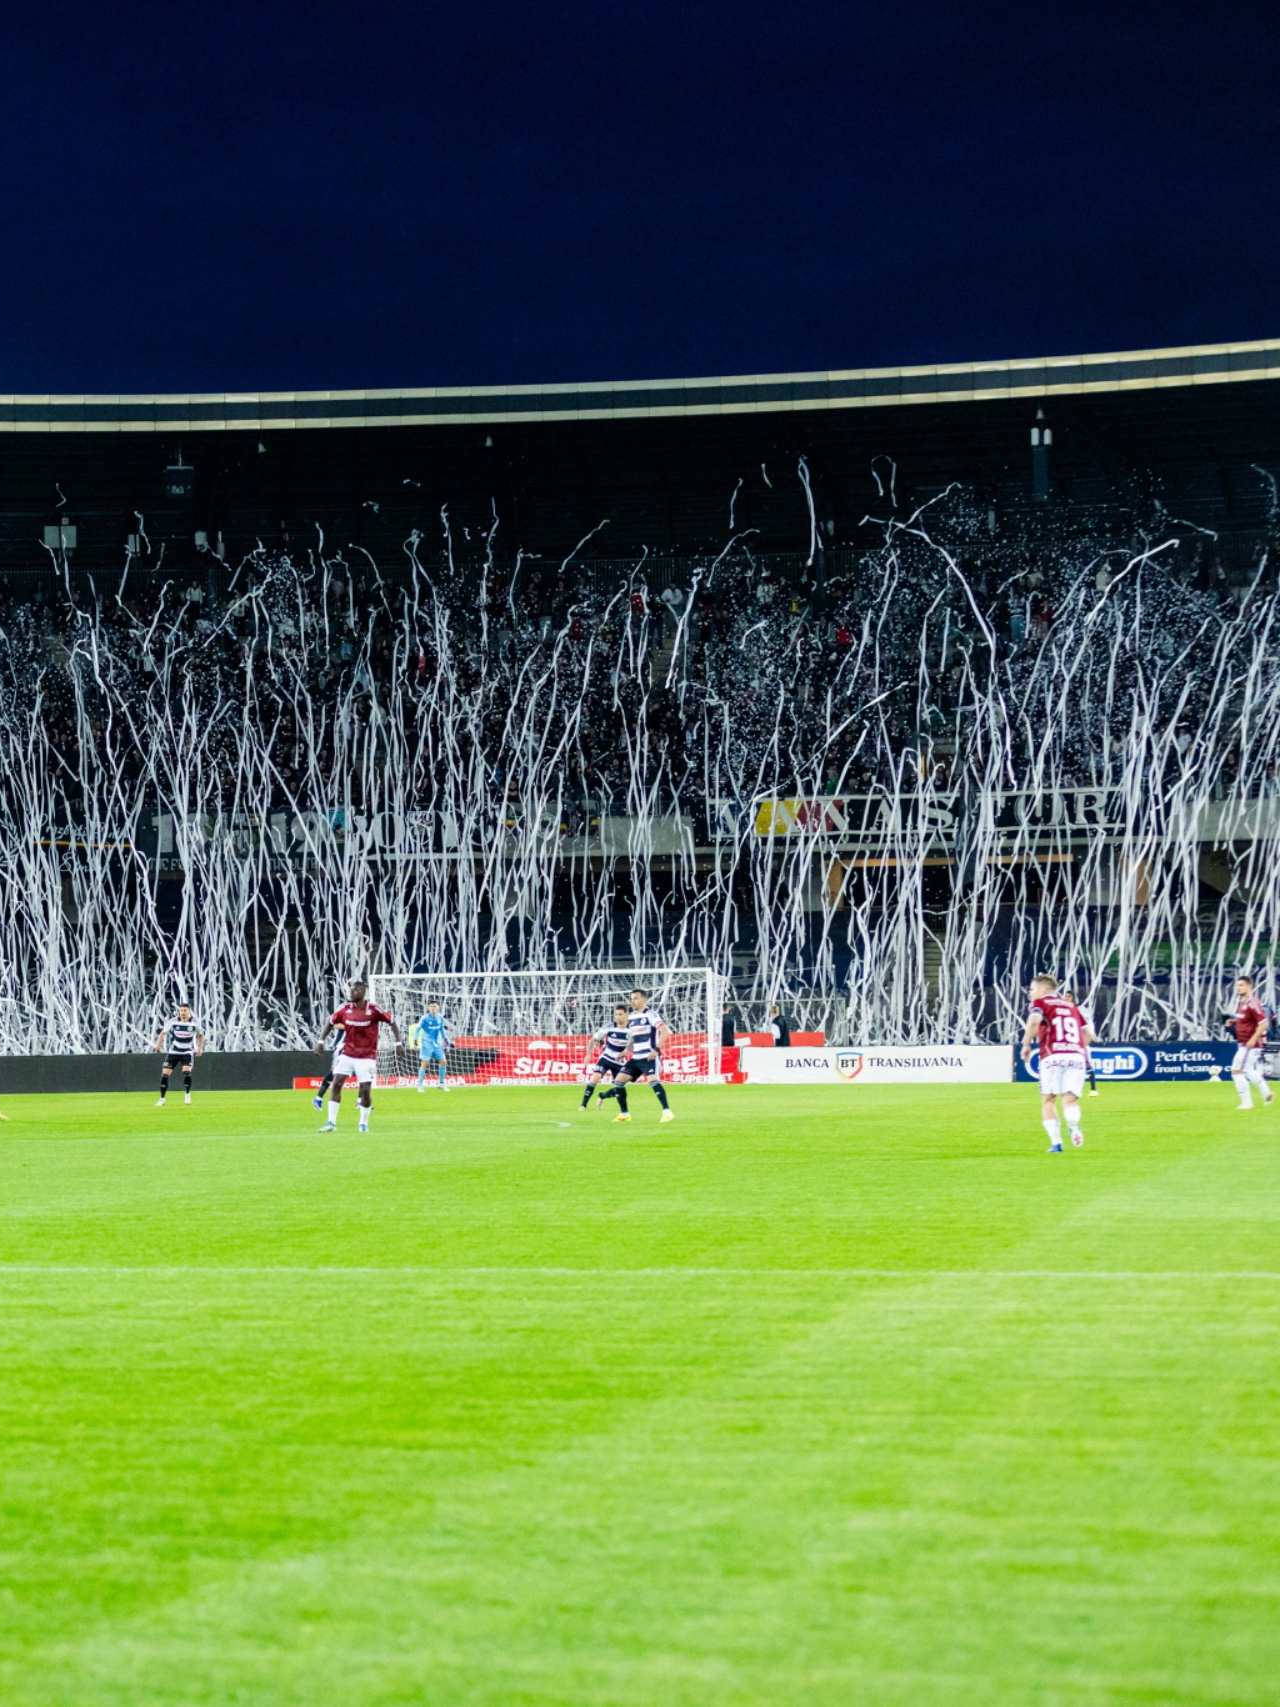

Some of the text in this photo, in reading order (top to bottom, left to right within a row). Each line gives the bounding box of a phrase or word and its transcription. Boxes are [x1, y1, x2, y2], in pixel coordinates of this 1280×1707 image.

[1051, 1015, 1079, 1043] 19
[1156, 1050, 1215, 1063] Perfetto.
[785, 1057, 963, 1068] BANCA BT TRANSILVANIA
[1155, 1064, 1181, 1073] from
[490, 1076, 549, 1085] SUPERBET
[672, 1073, 733, 1083] SUPERET
